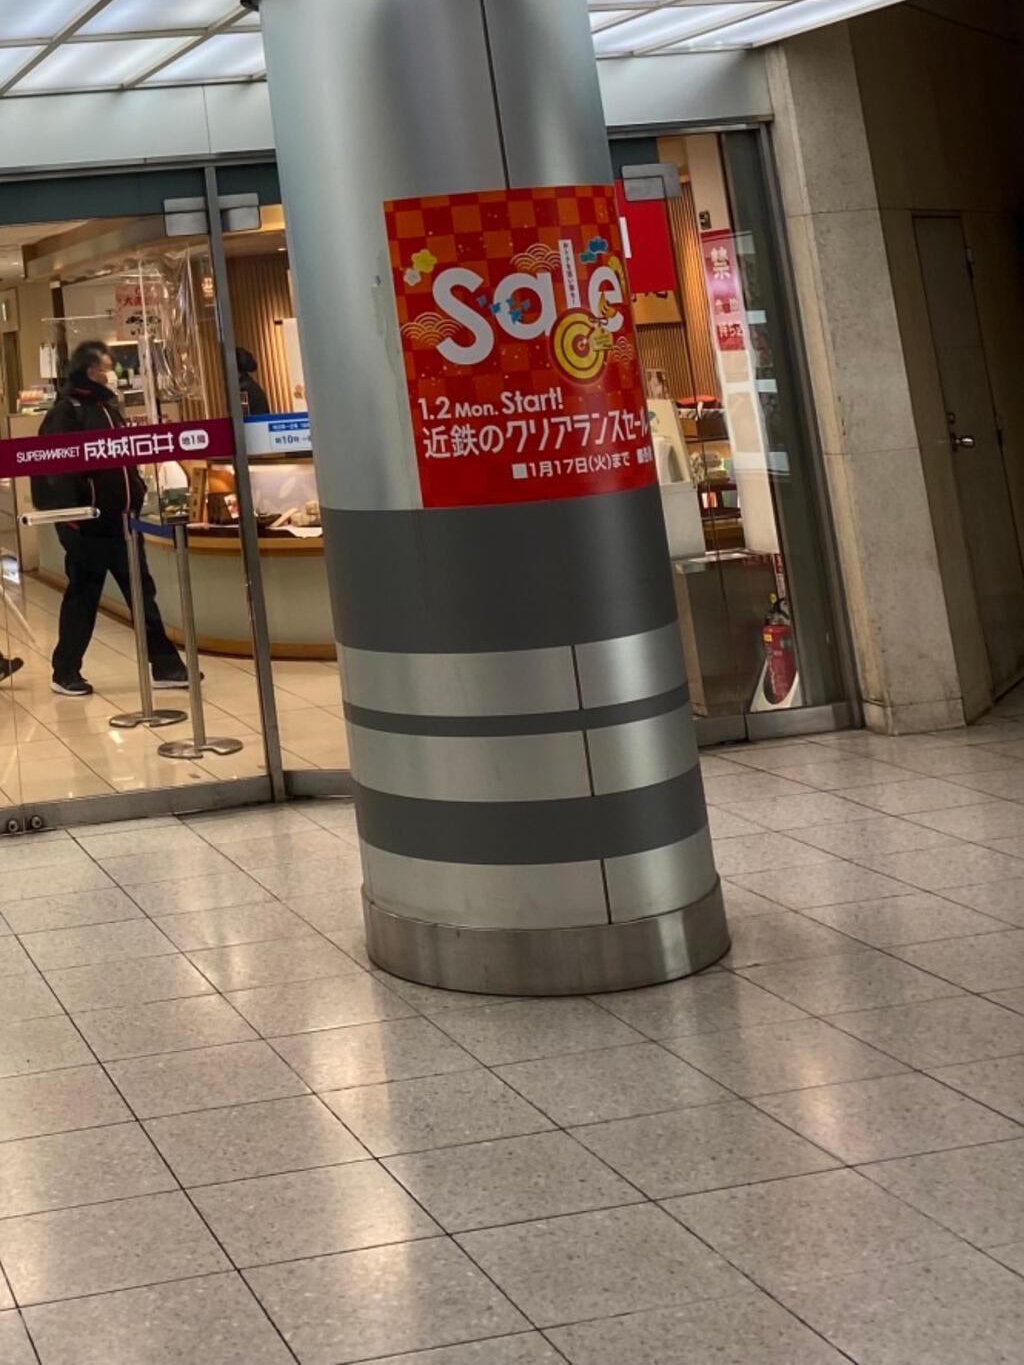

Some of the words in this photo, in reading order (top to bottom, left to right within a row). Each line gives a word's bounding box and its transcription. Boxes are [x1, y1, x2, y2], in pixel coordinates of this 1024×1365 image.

[455, 401, 499, 418] Mon.
[501, 387, 564, 414] Start!
[16, 445, 80, 464] SUPERMARKET
[84, 431, 175, 461] 成城石井
